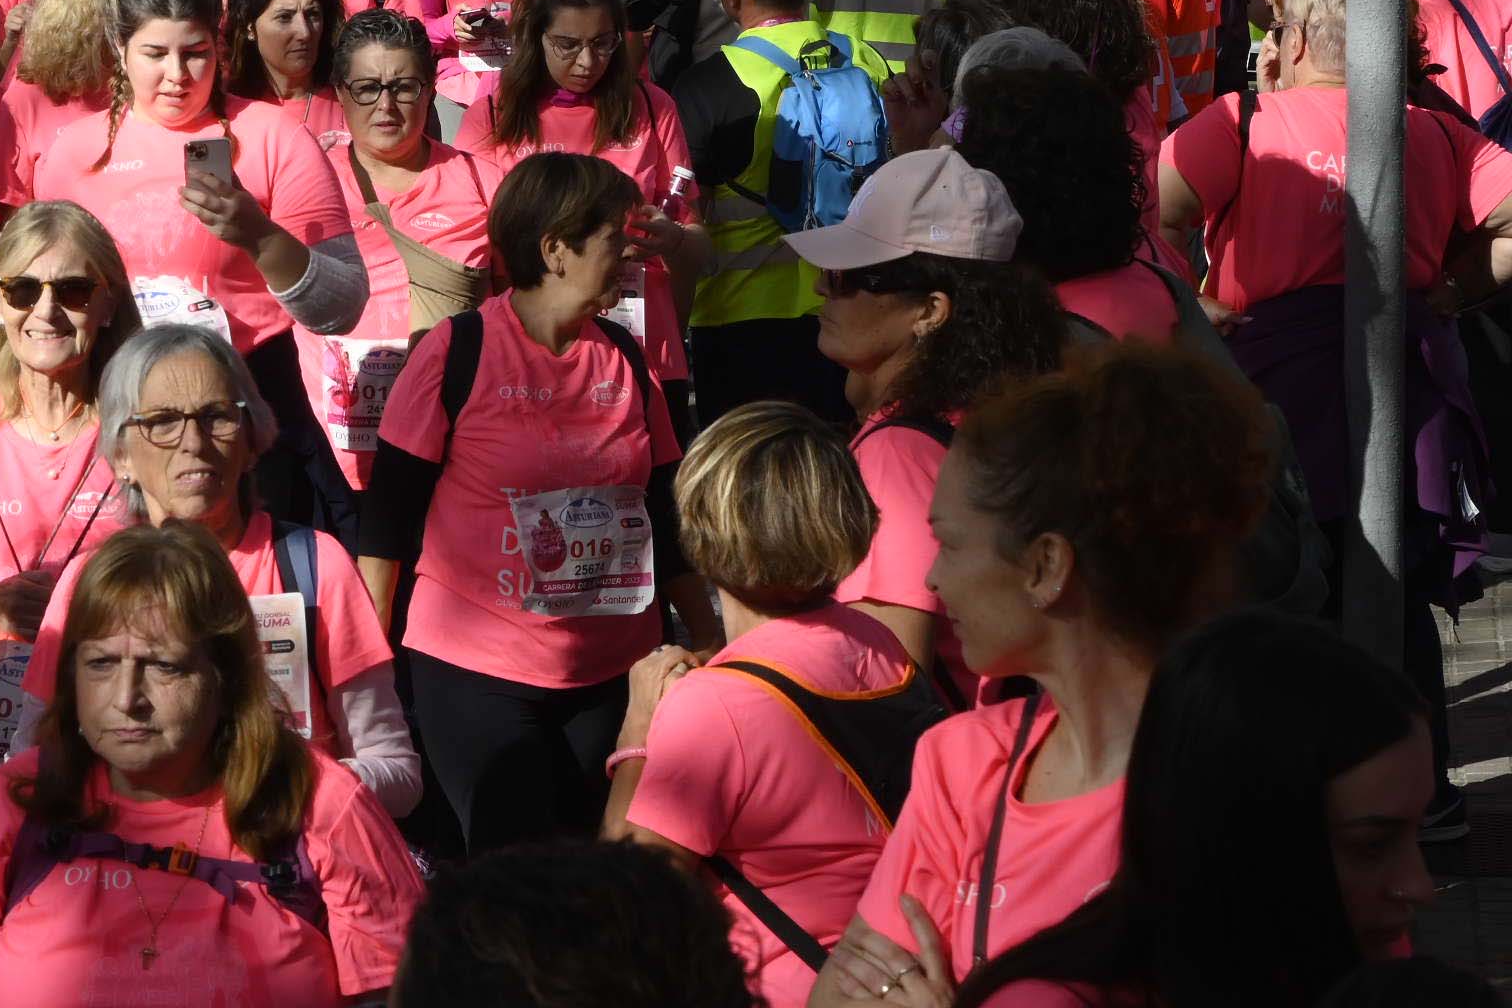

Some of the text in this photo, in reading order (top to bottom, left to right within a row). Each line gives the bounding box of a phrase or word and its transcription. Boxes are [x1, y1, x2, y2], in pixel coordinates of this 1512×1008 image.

[570, 538, 612, 559] 016
[543, 583, 577, 592] CARRERA
[602, 594, 645, 605] Santander
